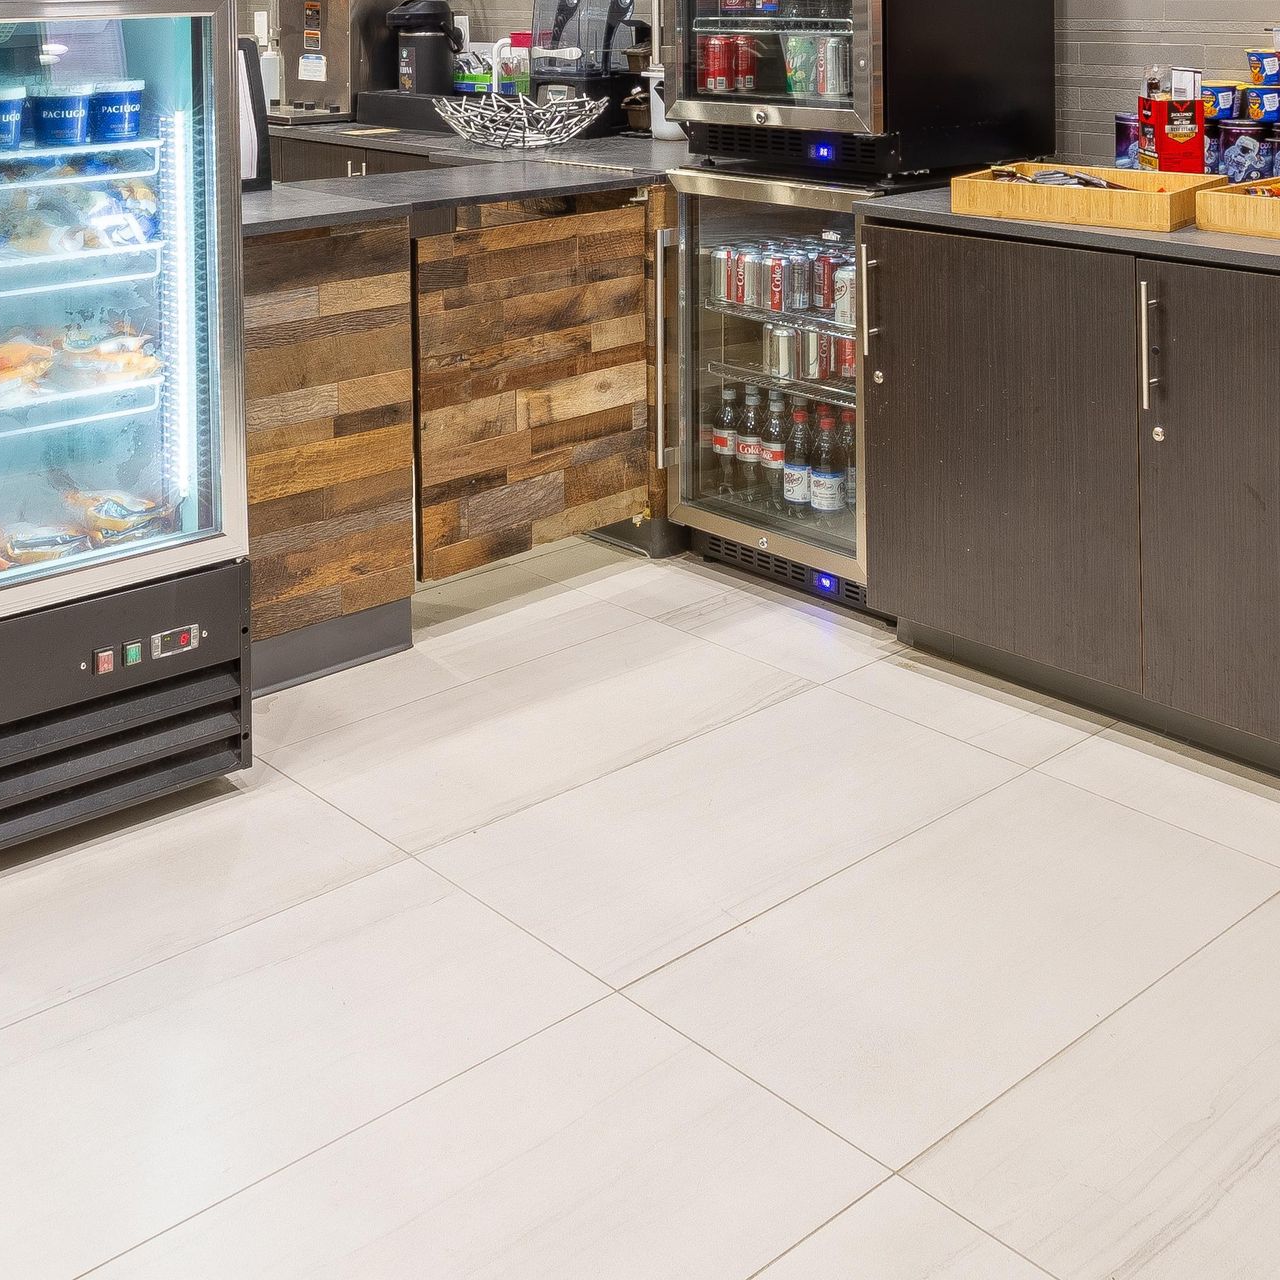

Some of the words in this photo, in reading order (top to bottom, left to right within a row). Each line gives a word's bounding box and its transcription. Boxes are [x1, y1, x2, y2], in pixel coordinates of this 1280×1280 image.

[42, 109, 85, 119] PACIUGO
[101, 103, 140, 114] PACIUGO
[771, 266, 783, 292] Coke
[739, 443, 762, 455] Coke
